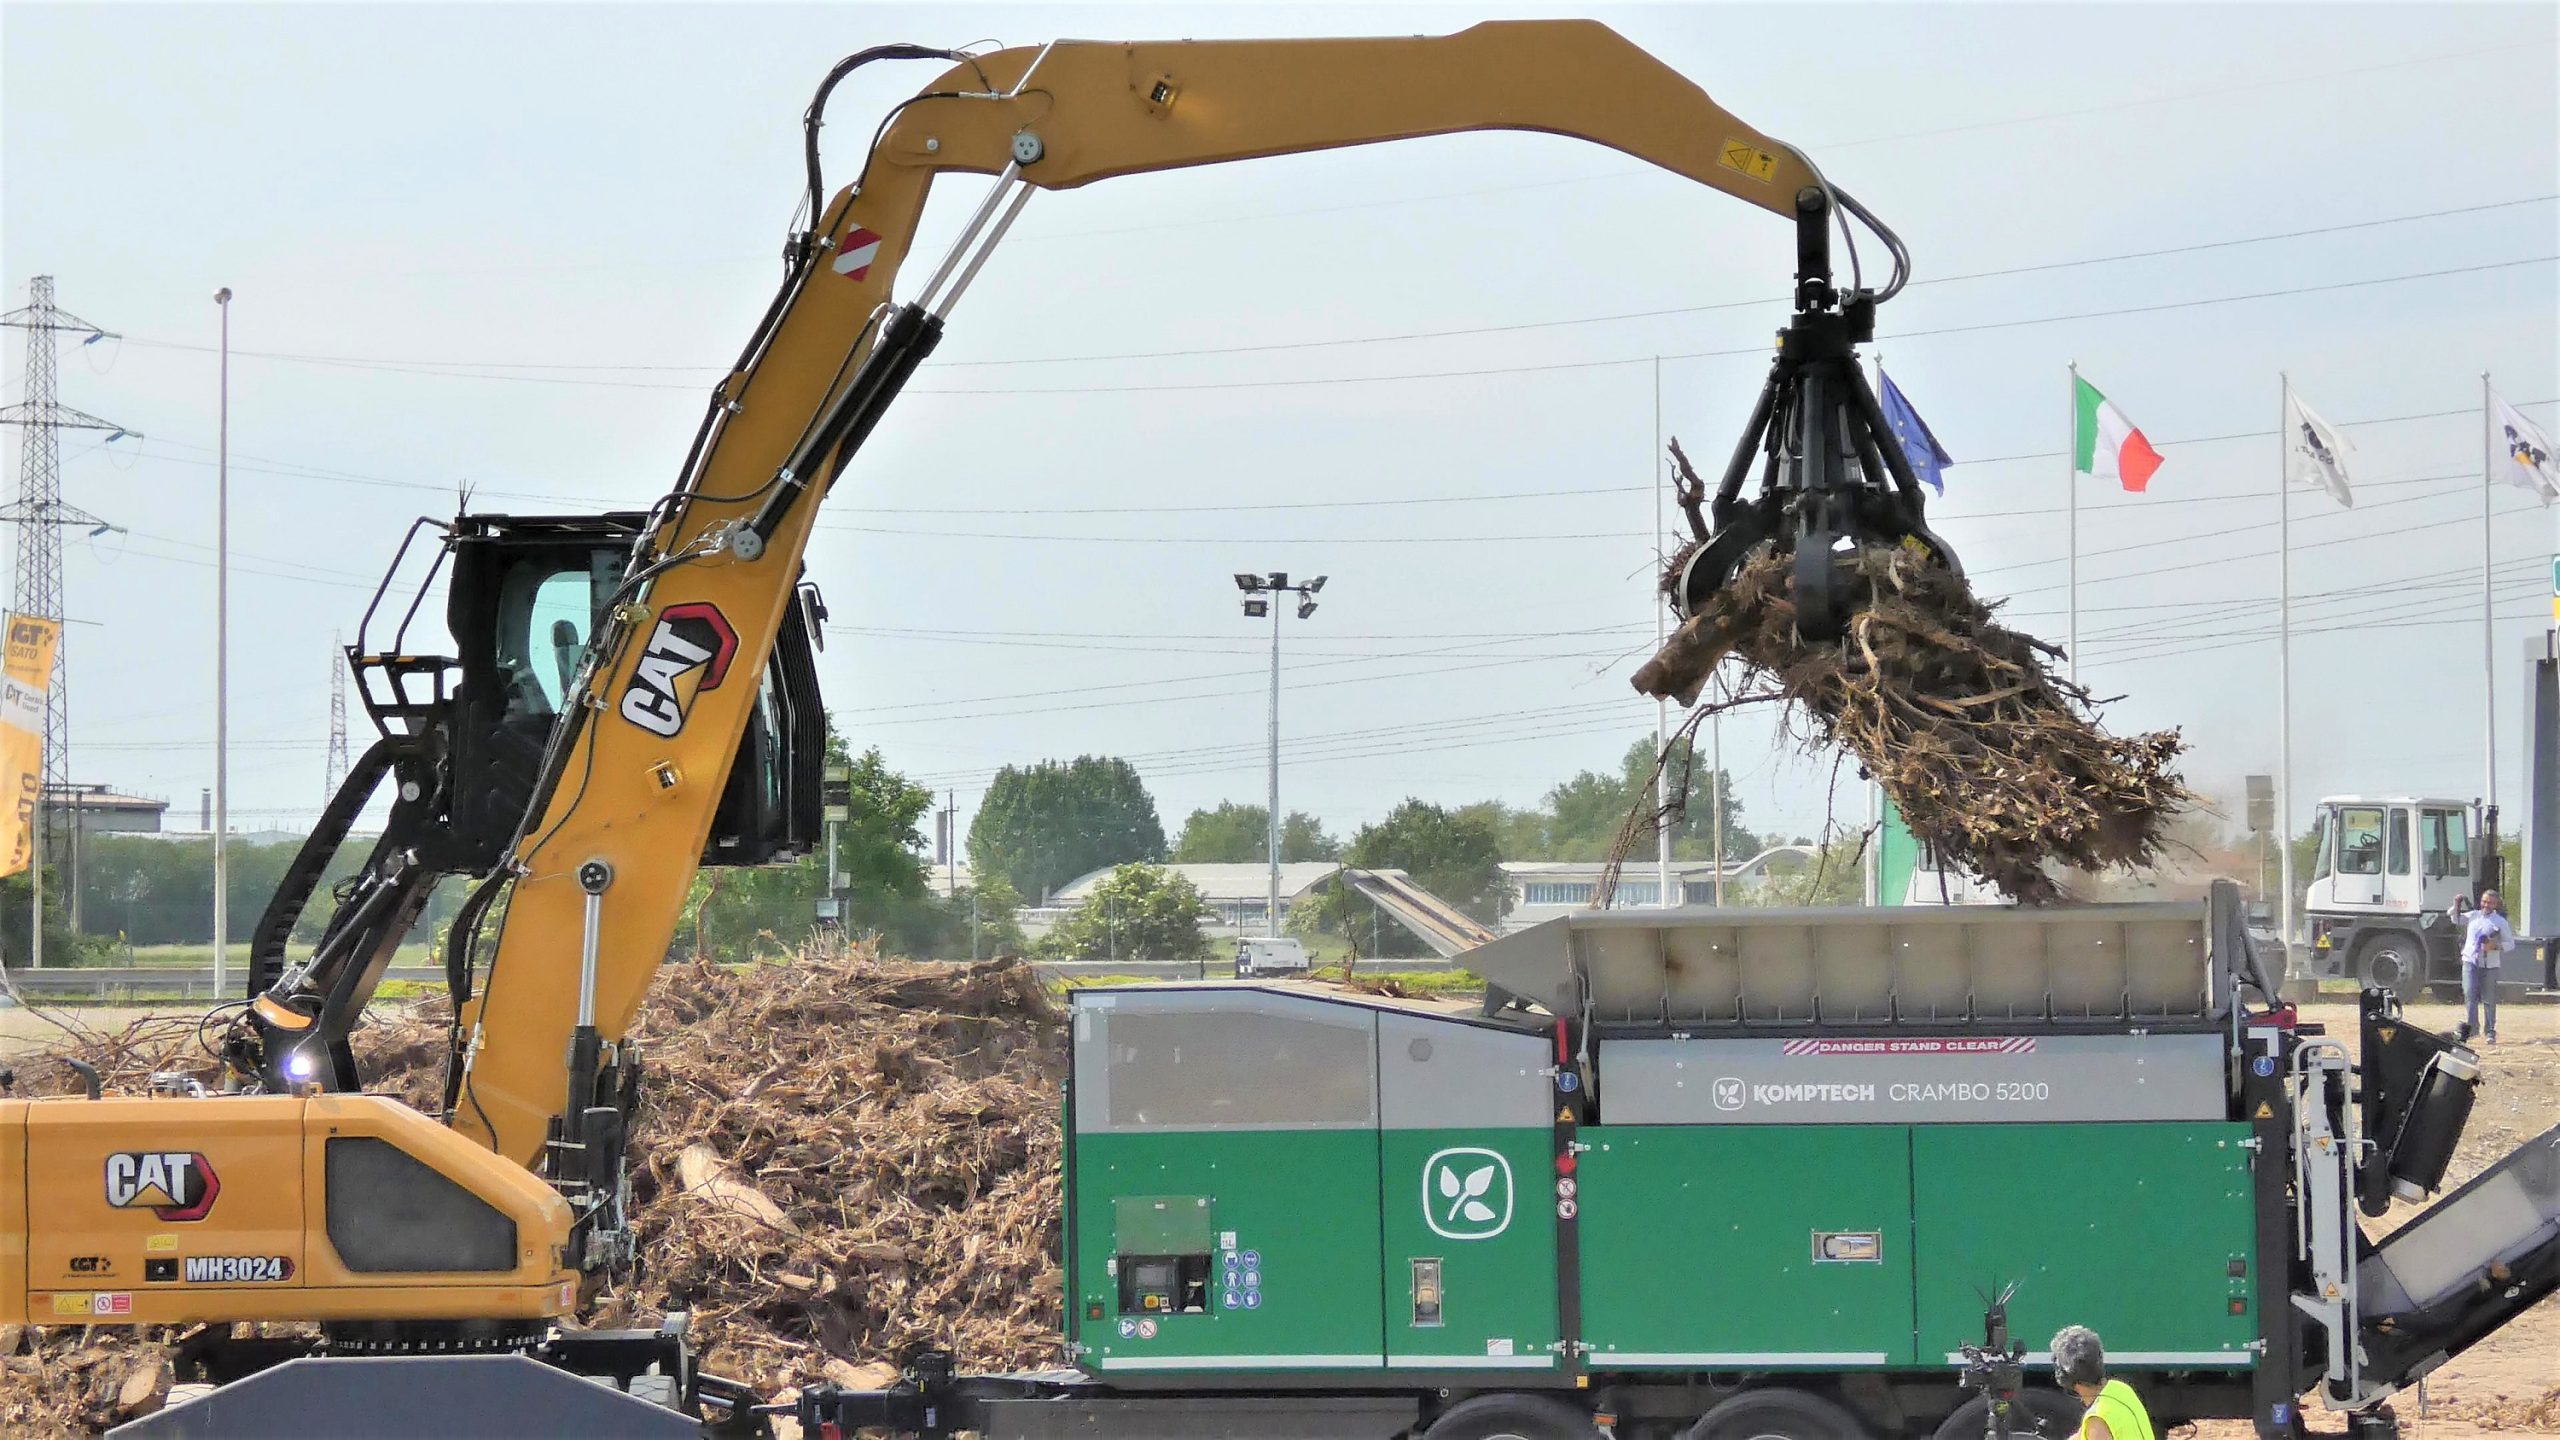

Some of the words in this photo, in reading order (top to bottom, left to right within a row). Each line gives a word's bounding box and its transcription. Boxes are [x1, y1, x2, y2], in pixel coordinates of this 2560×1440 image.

[621, 620, 712, 735] CAT
[1819, 1043, 1886, 1053] DANGER
[1889, 1042, 1941, 1051] STAND
[1945, 1041, 2001, 1051] CLEAR
[1753, 1084, 1875, 1105] KOMPTECH
[1889, 1083, 1990, 1101] CRAMBO
[1996, 1082, 2049, 1101] 5200
[107, 1153, 192, 1206] CAT
[186, 1257, 283, 1281] MH3024
